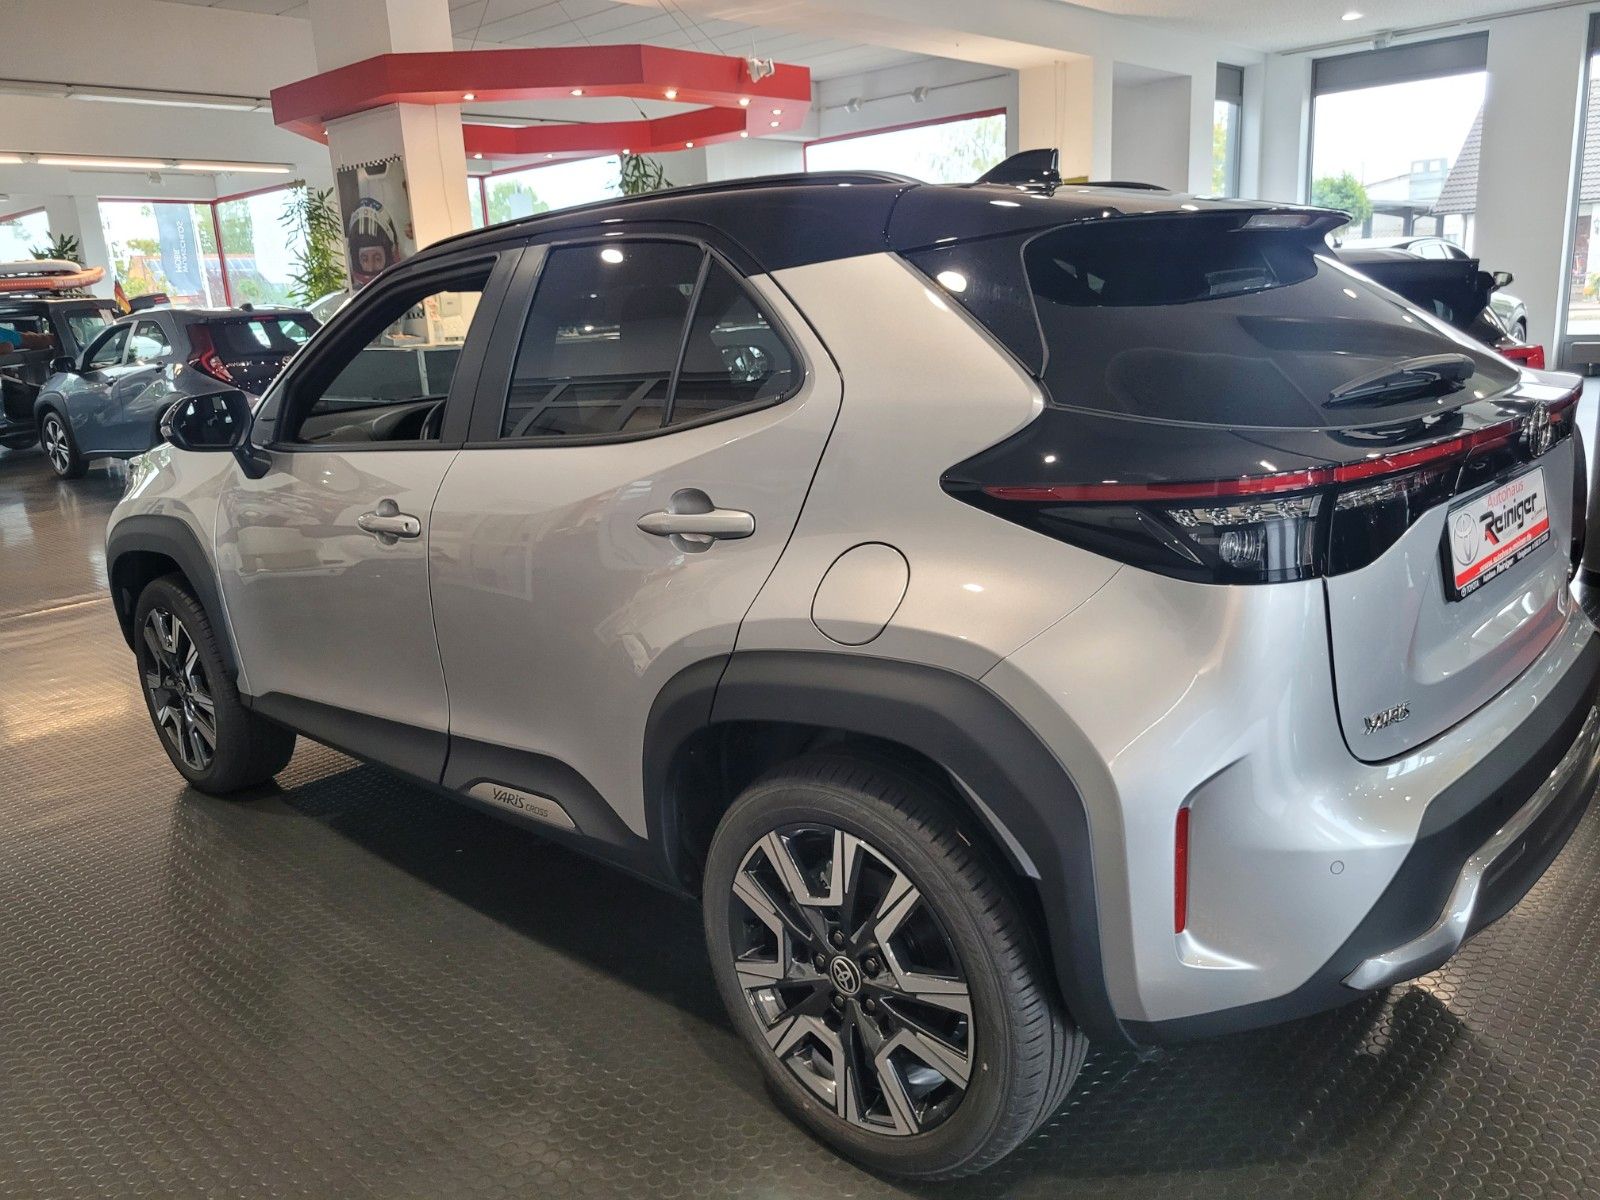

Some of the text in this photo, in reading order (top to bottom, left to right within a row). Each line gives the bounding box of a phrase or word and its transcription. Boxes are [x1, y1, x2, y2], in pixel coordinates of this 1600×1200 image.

[1487, 482, 1525, 510] Autohaus
[1479, 493, 1537, 545] Reiniger
[525, 803, 549, 817] CROSS
